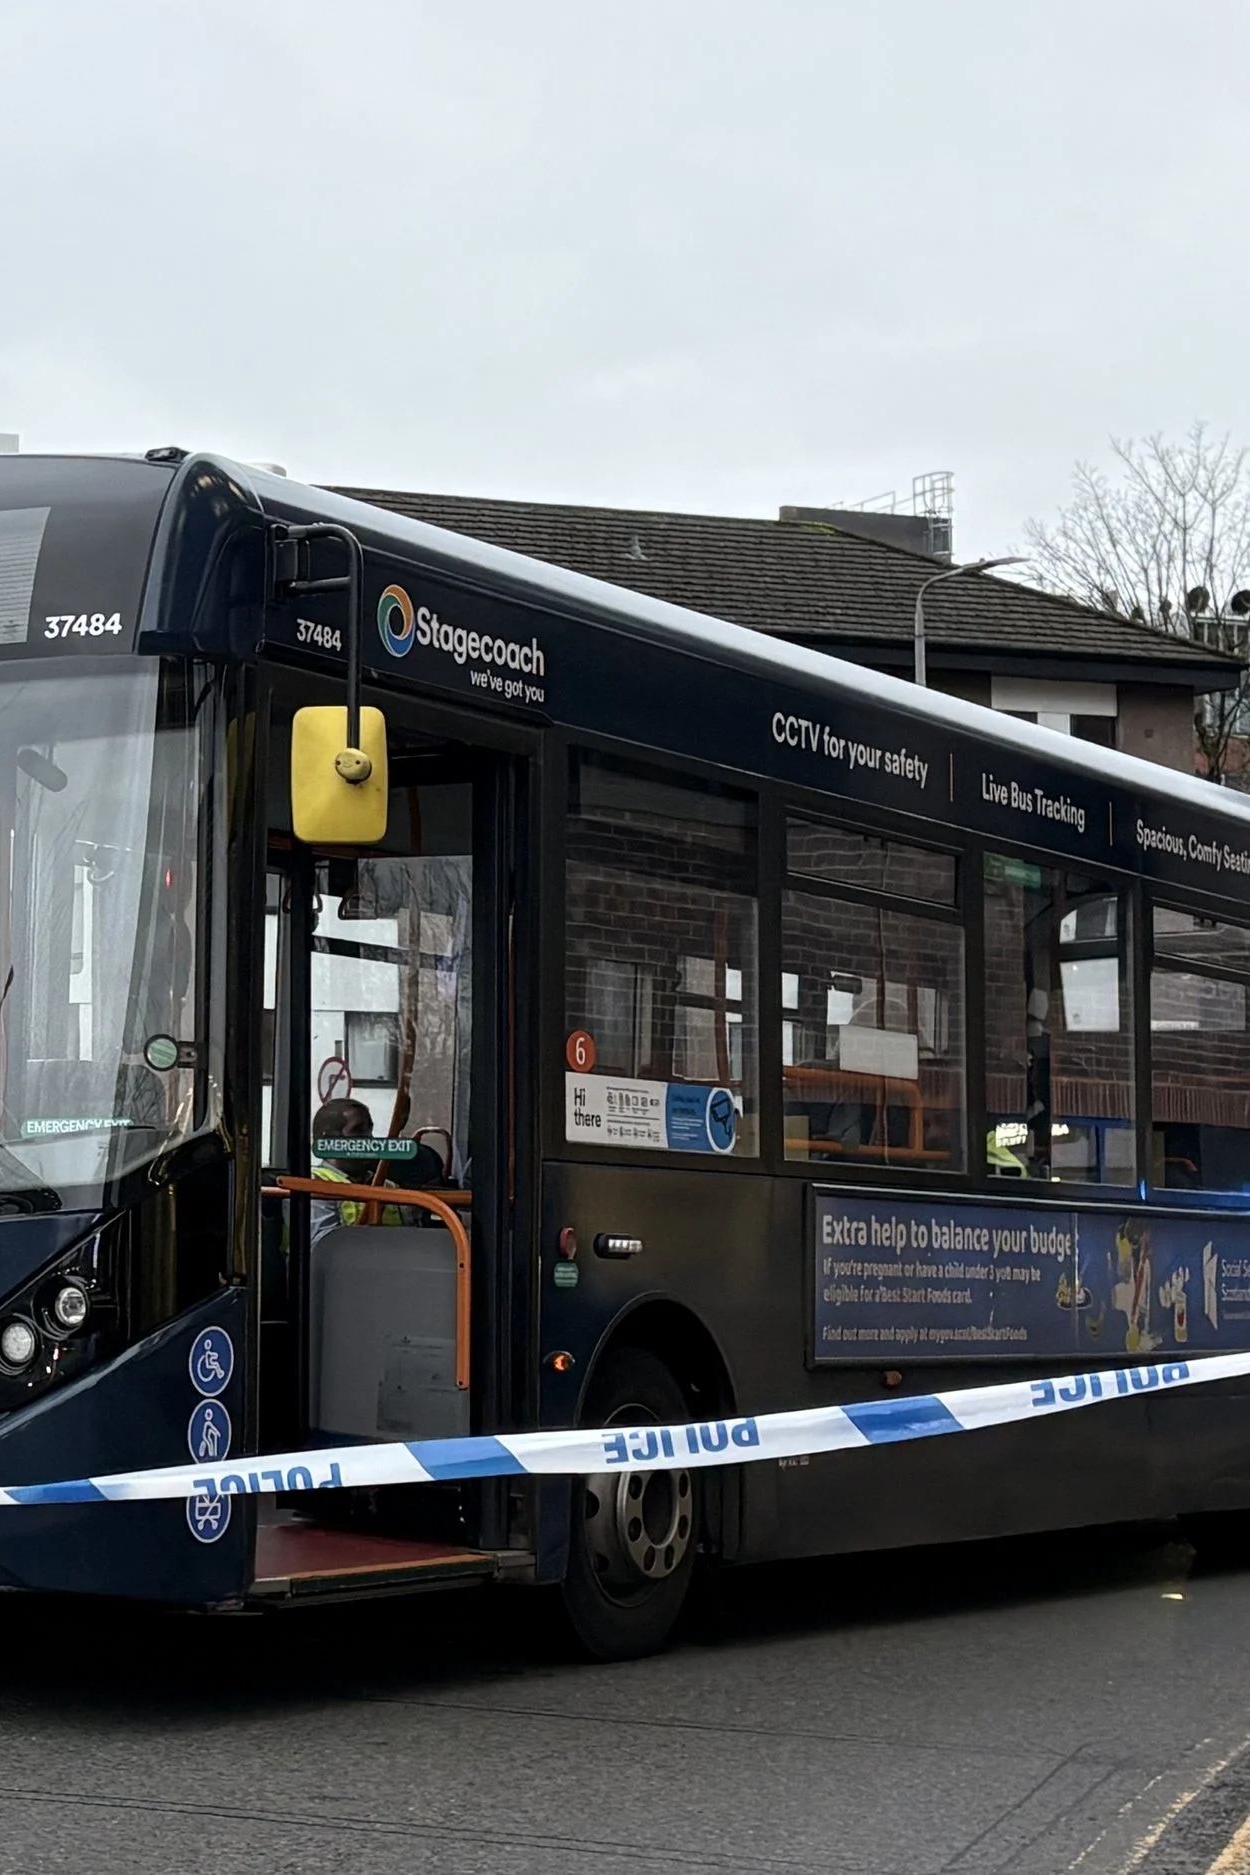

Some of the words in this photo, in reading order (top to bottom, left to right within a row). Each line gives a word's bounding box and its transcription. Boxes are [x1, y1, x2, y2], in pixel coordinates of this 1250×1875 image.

[43, 612, 123, 639] 37484
[296, 618, 342, 652] 37484
[416, 606, 545, 677] Stagecoach
[470, 669, 503, 692] we've
[504, 680, 524, 699] got
[524, 685, 545, 703] you
[772, 711, 821, 752] CCTV
[823, 726, 846, 760] for
[847, 741, 882, 770] your
[884, 748, 929, 789] safety
[982, 772, 1009, 806] Live
[1011, 781, 1033, 813] Bus
[1034, 788, 1086, 833] Tracking
[1136, 818, 1187, 861] Spacious,
[1188, 834, 1223, 872] Comfy
[575, 1037, 586, 1065] 6
[574, 1087, 586, 1107] Hi
[26, 1119, 103, 1133] EMERGENCY
[574, 1108, 602, 1128] there
[317, 1138, 387, 1152] EMERGENCY
[387, 1139, 413, 1152] EXIT
[822, 1215, 868, 1246] Extra
[871, 1214, 907, 1256] help
[911, 1219, 928, 1249] to
[931, 1218, 989, 1251] balance
[992, 1229, 1028, 1259] your
[1030, 1224, 1078, 1263] budge
[823, 1257, 832, 1276] If
[833, 1260, 862, 1280] you're
[863, 1261, 902, 1281] pregnant
[903, 1264, 914, 1277] or
[915, 1260, 937, 1278] have
[937, 1265, 944, 1278] a
[944, 1261, 965, 1279] child
[965, 1264, 989, 1280] under
[1012, 1267, 1030, 1285] may
[1030, 1265, 1041, 1282] be
[823, 1284, 859, 1306] eligible
[860, 1285, 874, 1302] for
[901, 1287, 926, 1304] Start
[1029, 1361, 1191, 1408] POLICE
[601, 1417, 760, 1464] POLICE
[192, 1462, 343, 1500] POLICE
